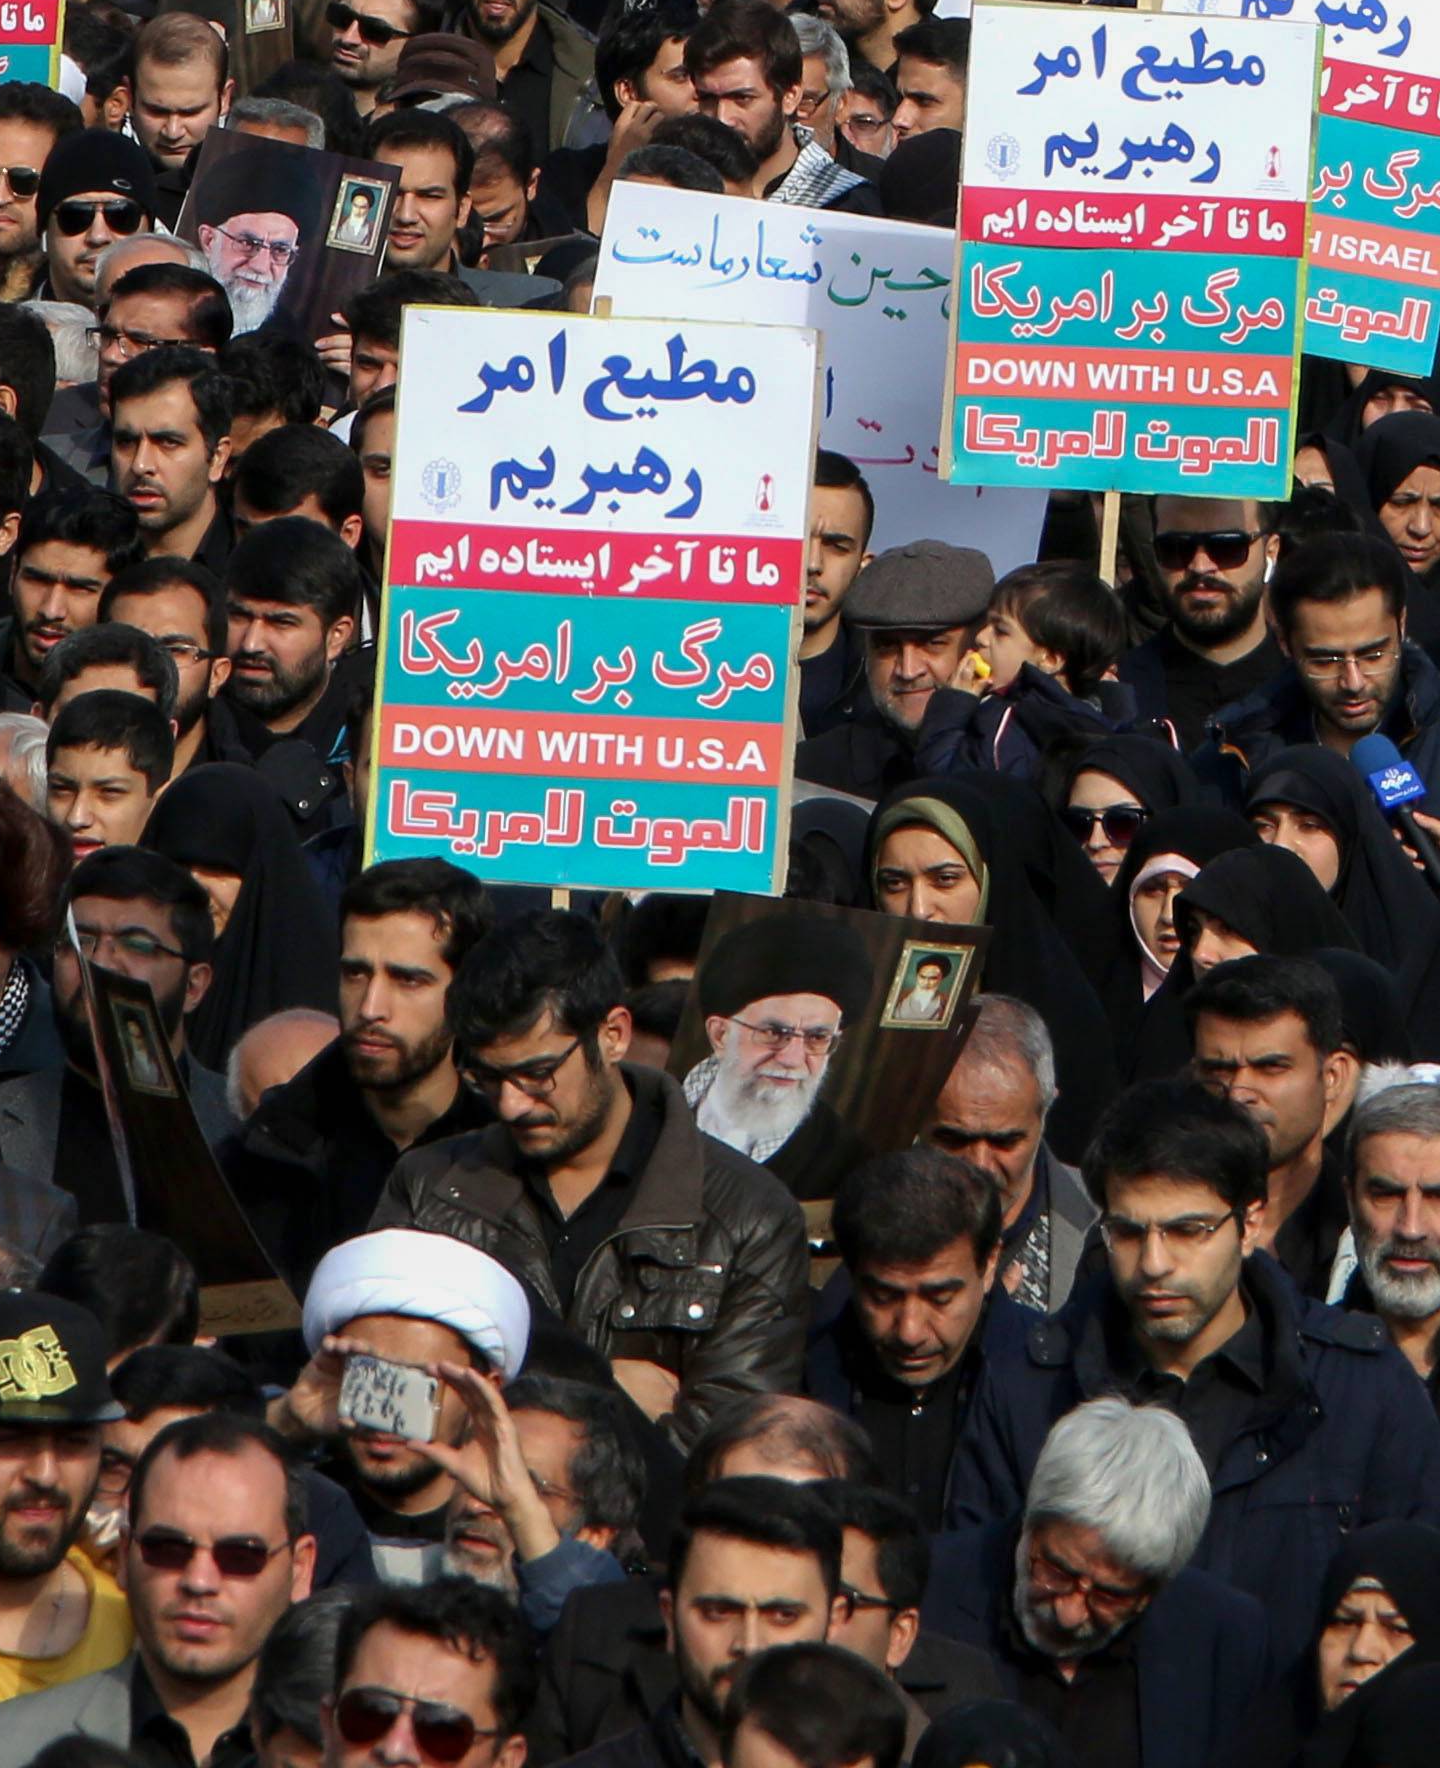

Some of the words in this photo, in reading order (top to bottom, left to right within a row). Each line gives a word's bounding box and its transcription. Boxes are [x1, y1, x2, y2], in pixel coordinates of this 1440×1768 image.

[1016, 23, 1106, 95] امر
[1121, 26, 1266, 102] مطیع
[1044, 121, 1222, 183] رهبریم
[981, 199, 1027, 239] ایم
[1035, 203, 1145, 245] ایستاده
[1152, 203, 1219, 246] آخر
[1227, 206, 1251, 238] تا
[1257, 209, 1287, 242] ما
[970, 260, 1113, 339] امریکا
[1115, 290, 1169, 344] بر
[1181, 268, 1285, 345] مرگ
[456, 328, 568, 414] امر
[582, 332, 756, 421] مطیع
[967, 358, 1076, 389] DOWN
[1086, 362, 1175, 393] WITH
[1186, 367, 1279, 397] U.S.A
[1136, 416, 1279, 476] الموت
[489, 445, 702, 519] رهبریم
[415, 534, 470, 583] ایم
[478, 540, 612, 589] ایستاده
[618, 540, 700, 593] آخر
[708, 546, 736, 586] تا
[745, 547, 781, 587] ما
[399, 608, 571, 701] امریکا
[572, 644, 637, 708] بر
[652, 618, 775, 710] مرگ
[392, 723, 524, 761] DOWN
[537, 731, 644, 766] WITH
[655, 736, 767, 772] U.S.A
[594, 797, 766, 866] الموت
